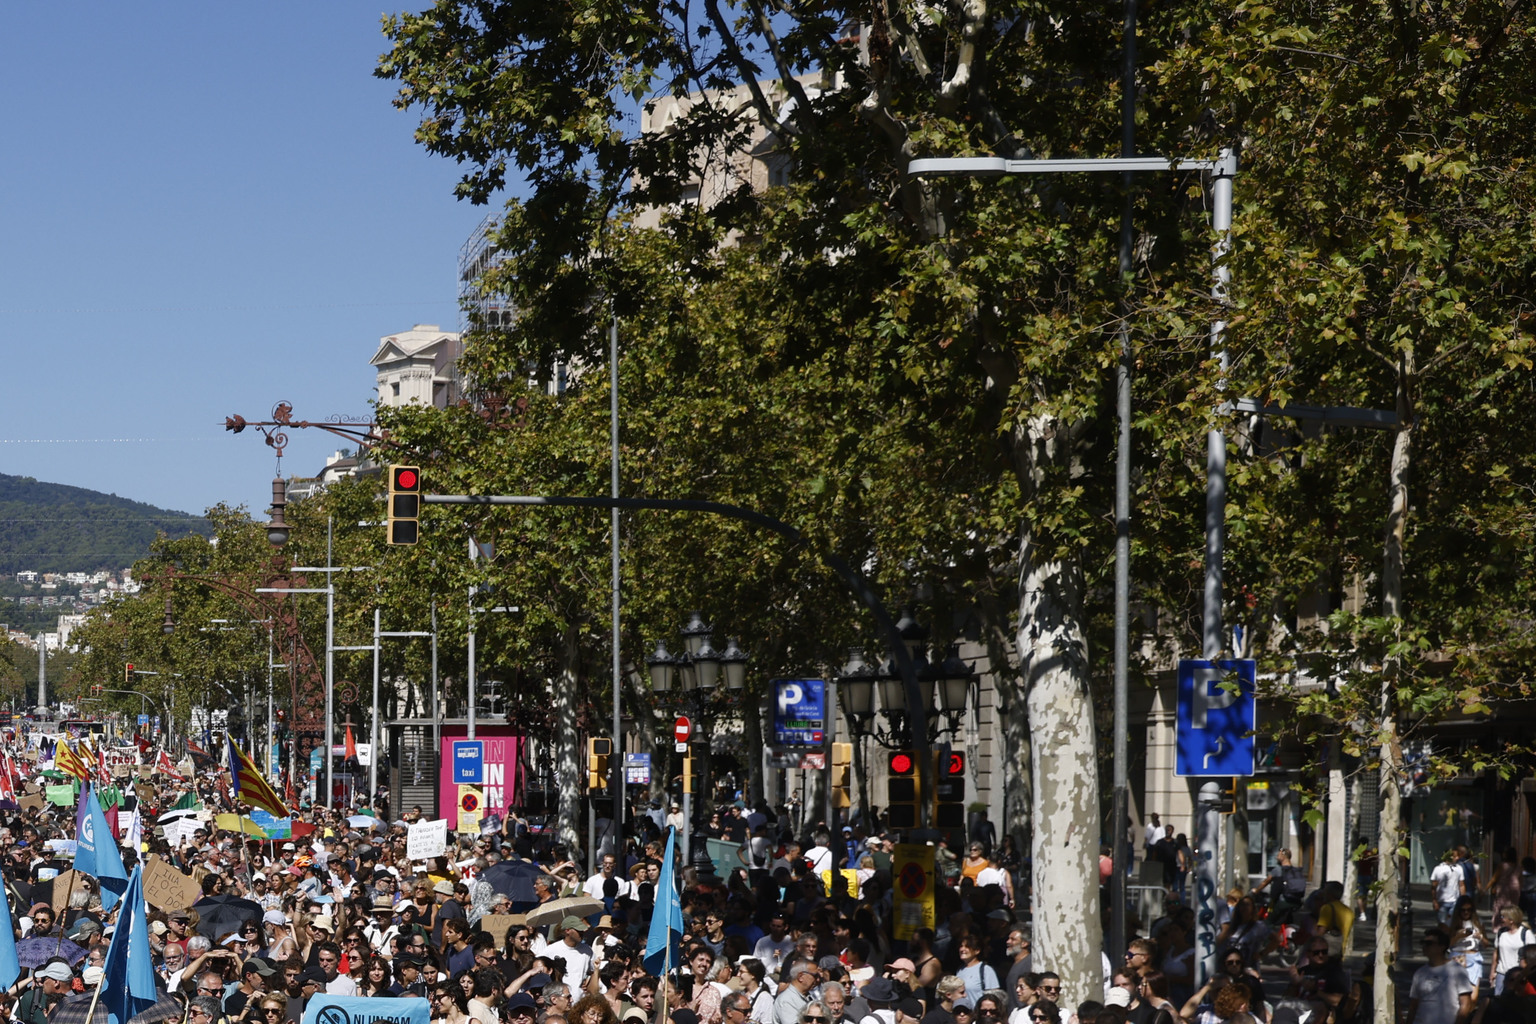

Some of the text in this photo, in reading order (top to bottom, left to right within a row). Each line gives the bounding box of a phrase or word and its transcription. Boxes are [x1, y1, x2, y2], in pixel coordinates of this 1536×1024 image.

[778, 684, 803, 715] P
[1191, 668, 1240, 729] P
[462, 768, 474, 777] taxi
[153, 873, 186, 901] TOCA
